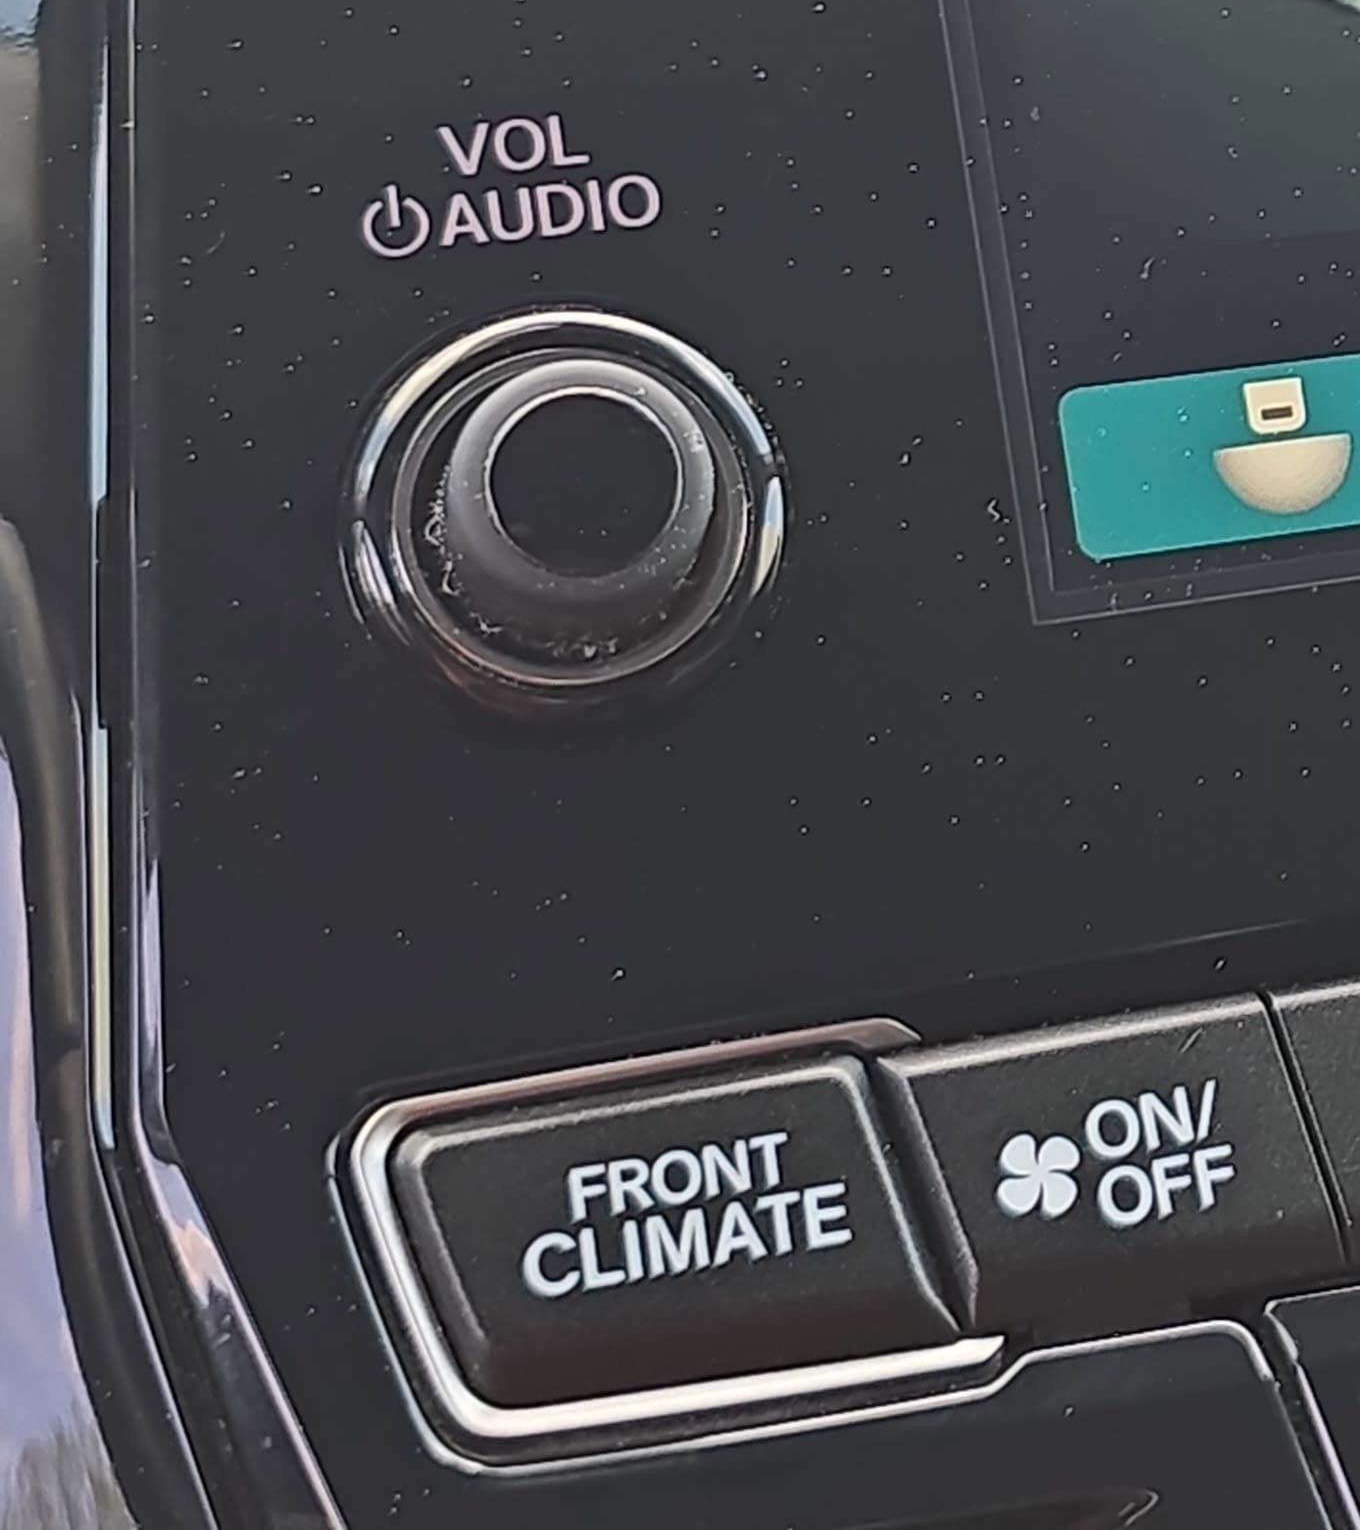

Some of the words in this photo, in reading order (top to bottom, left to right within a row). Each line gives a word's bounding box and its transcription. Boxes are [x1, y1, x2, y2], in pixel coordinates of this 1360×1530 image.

[437, 114, 591, 176] VOL
[439, 174, 662, 247] AUDIO
[1082, 1079, 1219, 1162] ON/
[566, 1130, 790, 1226] FRONT
[1094, 1143, 1236, 1230] OFF
[520, 1180, 854, 1300] CLIMATE
